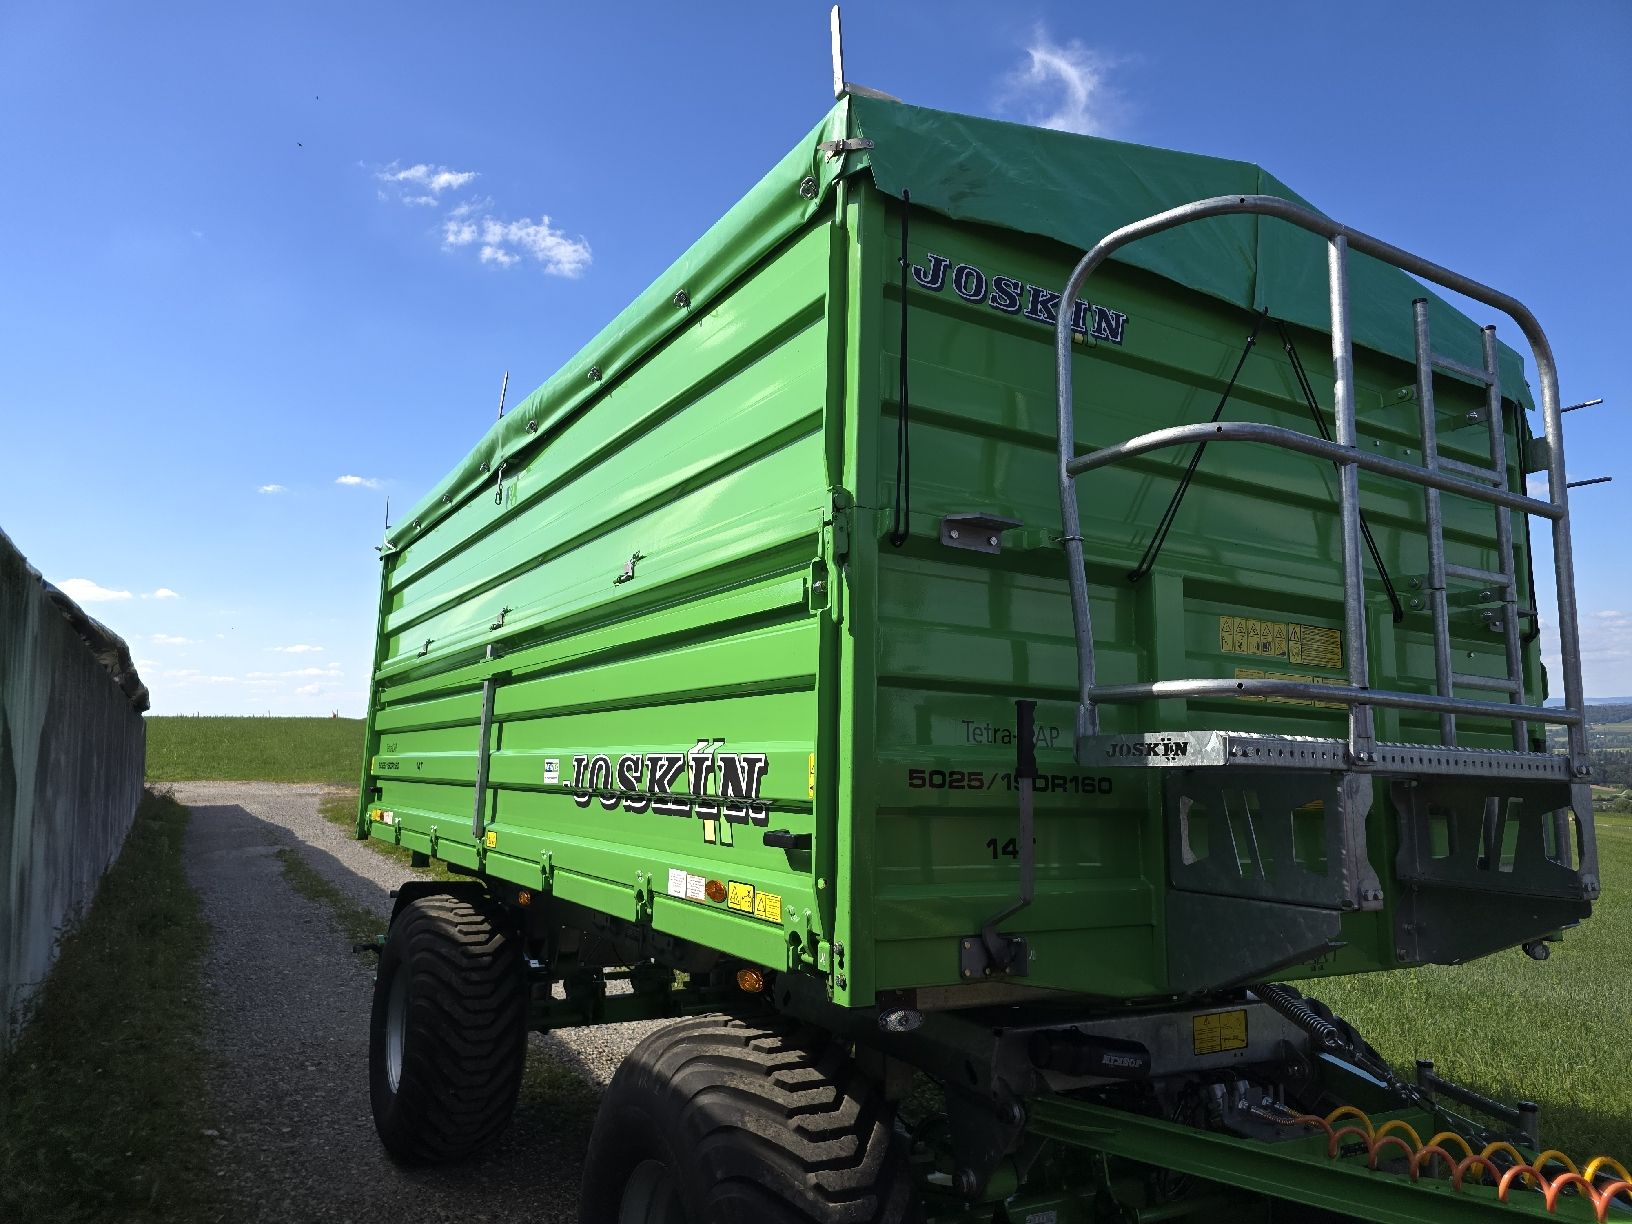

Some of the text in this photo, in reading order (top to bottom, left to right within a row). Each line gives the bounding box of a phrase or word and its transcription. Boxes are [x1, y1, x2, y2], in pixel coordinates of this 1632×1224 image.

[912, 253, 1129, 344] JOSKIN
[961, 719, 1060, 748] Tetra-AP
[1105, 739, 1188, 759] JOSKIN
[562, 751, 769, 828] JOSKIN
